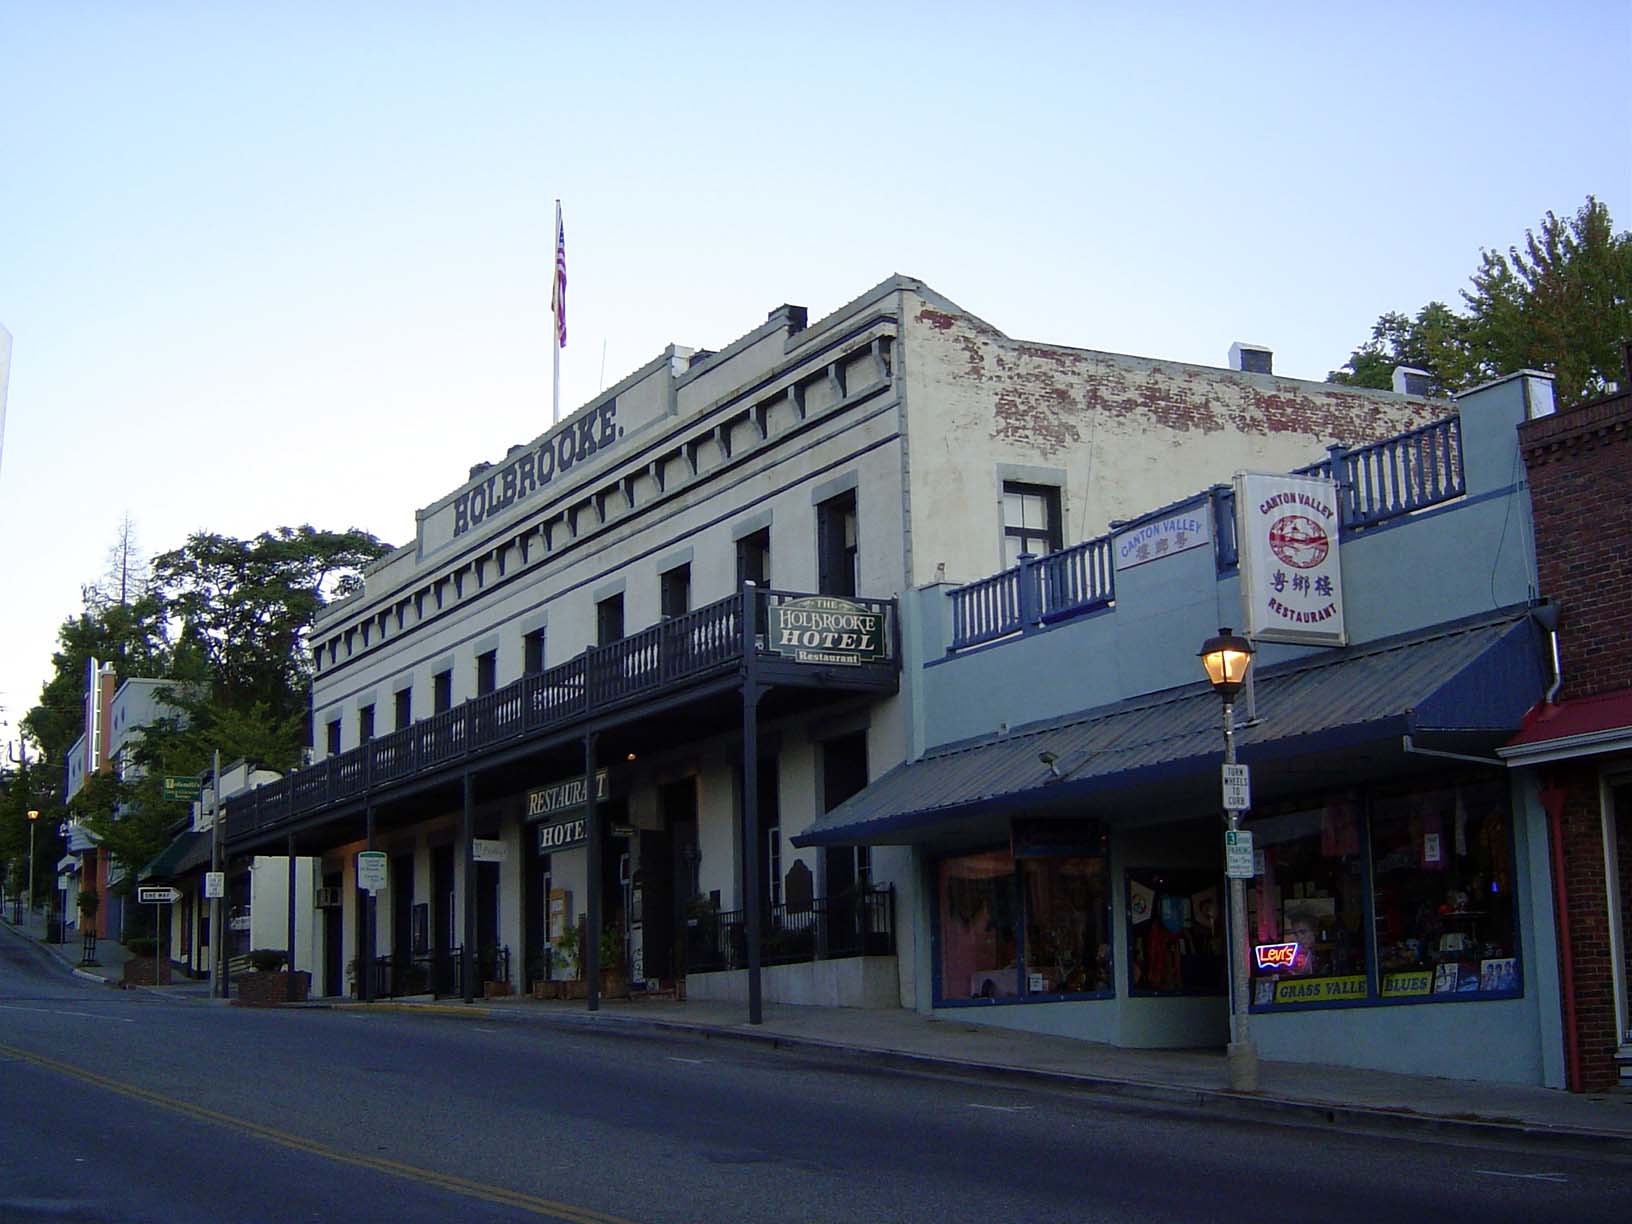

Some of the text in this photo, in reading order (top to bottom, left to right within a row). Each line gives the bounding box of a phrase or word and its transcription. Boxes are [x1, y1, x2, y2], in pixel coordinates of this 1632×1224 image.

[1260, 492, 1334, 520] CANTON VALLEY
[1120, 519, 1202, 558] CANTON VALLEY
[817, 600, 838, 609] THE
[1268, 597, 1337, 624] RESTAURANT
[779, 610, 876, 634] HOLBROOKE
[779, 629, 876, 651] HOTEL
[799, 650, 858, 664] Restaurant
[1227, 767, 1244, 776] TURN
[1224, 777, 1248, 786] WHEELS
[528, 773, 607, 817] RESTAURAT
[1232, 787, 1241, 796] TO
[1228, 796, 1245, 806] CURB
[542, 819, 588, 848] HOTE
[1260, 945, 1294, 961] Levi's
[1280, 979, 1367, 998] GRASS VALLE
[1386, 977, 1428, 992] BLUES
